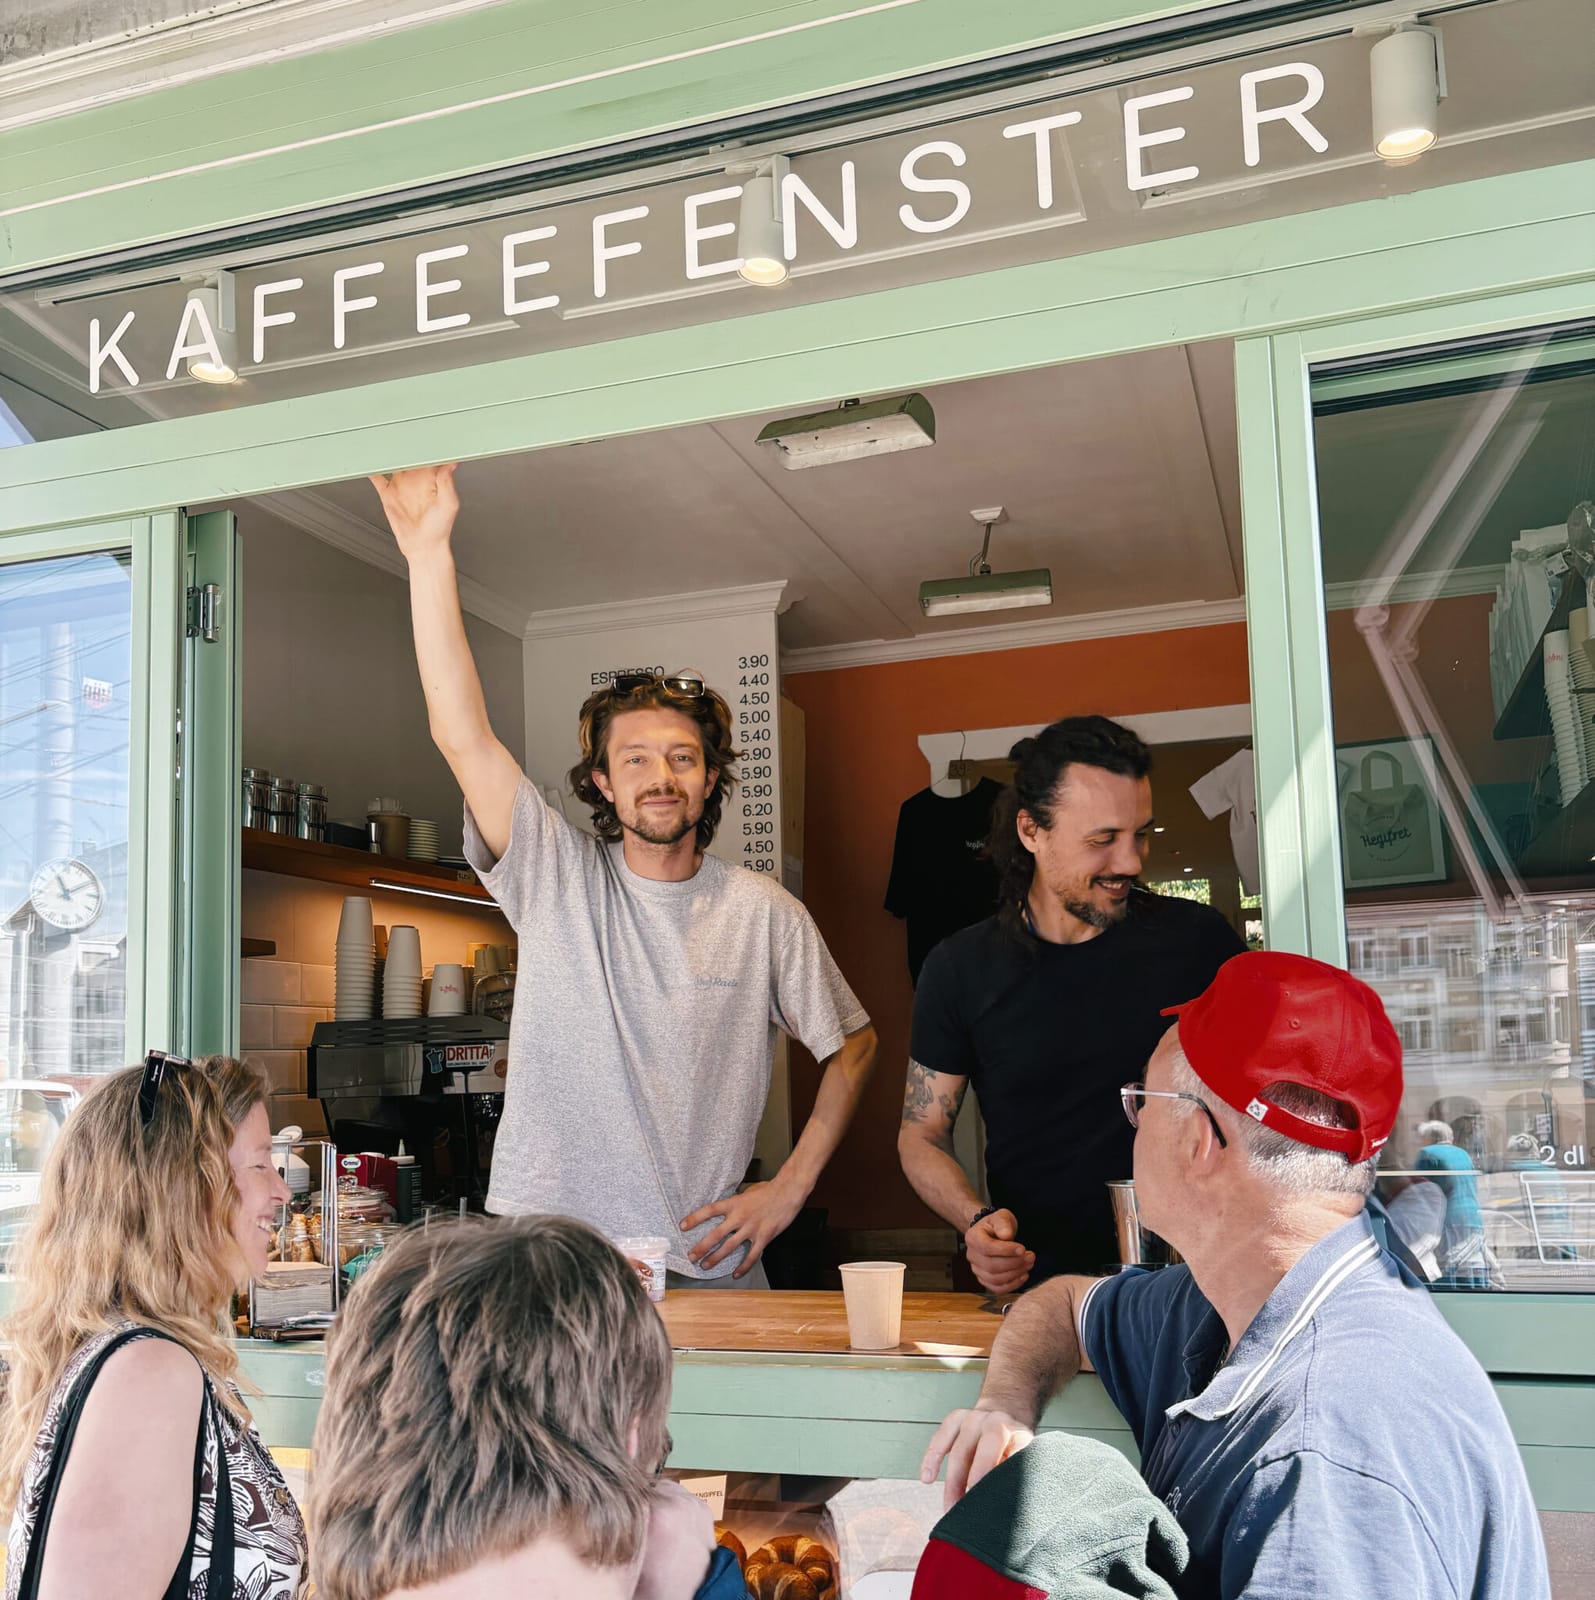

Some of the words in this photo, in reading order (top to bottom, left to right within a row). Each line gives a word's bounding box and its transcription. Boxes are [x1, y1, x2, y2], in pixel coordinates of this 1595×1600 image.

[90, 62, 1328, 393] KAFFEEFENSTER
[738, 654, 769, 669] 3.90
[739, 672, 769, 688] 4.40
[740, 691, 770, 706] 4.50
[740, 710, 770, 725] 5.00
[740, 728, 771, 743] 5.40
[741, 747, 771, 762] 5.90
[741, 765, 772, 780] 5.90
[742, 784, 772, 799] 5.90
[743, 802, 773, 817] 6.20
[743, 821, 773, 836] 5.90
[743, 840, 774, 855] 4.50
[743, 858, 775, 873] 5.90
[447, 1046, 490, 1061] DRITTA
[1540, 1145, 1557, 1166] 2
[1563, 1145, 1585, 1165] dl
